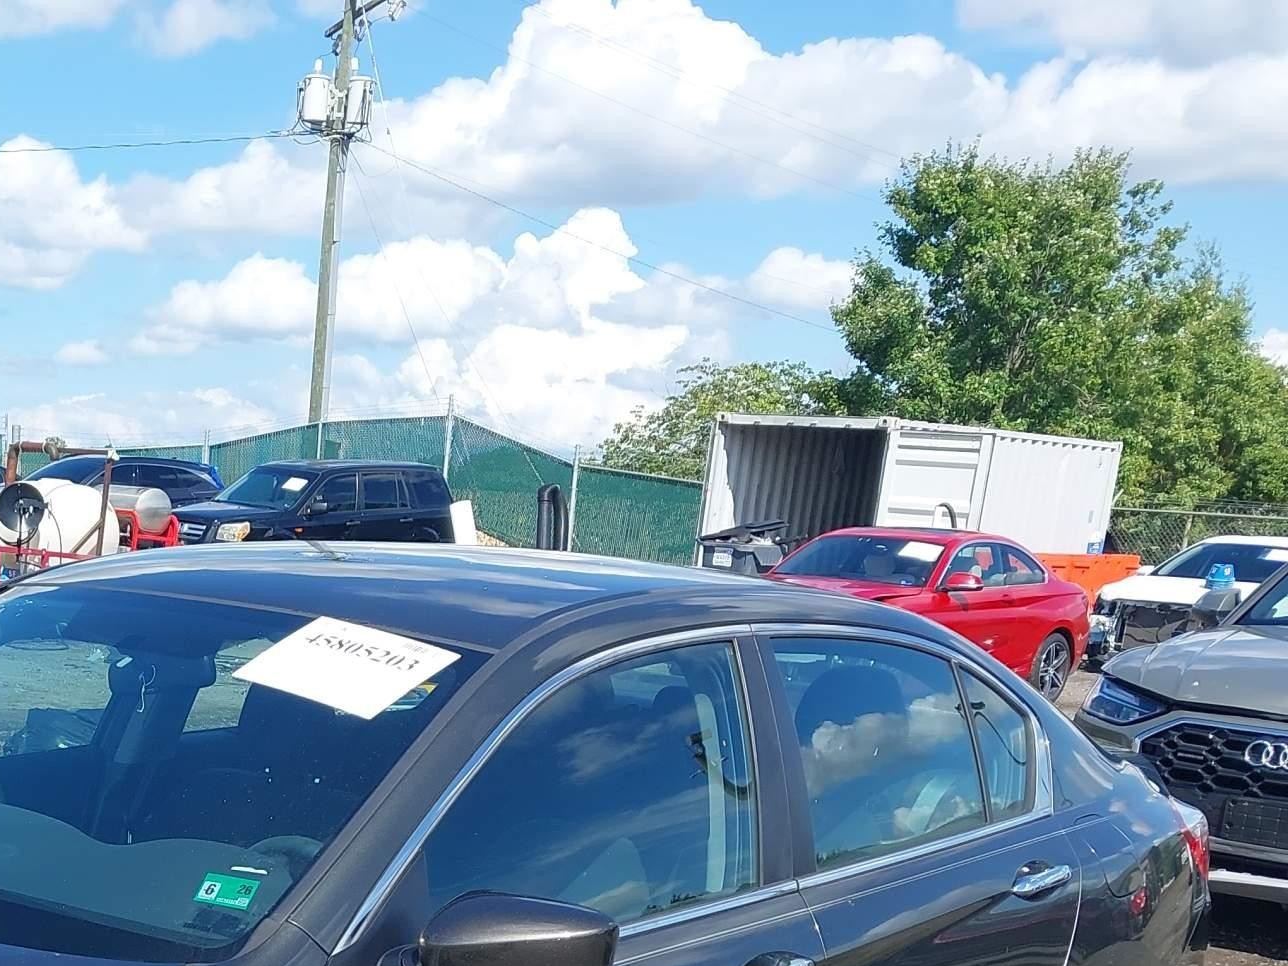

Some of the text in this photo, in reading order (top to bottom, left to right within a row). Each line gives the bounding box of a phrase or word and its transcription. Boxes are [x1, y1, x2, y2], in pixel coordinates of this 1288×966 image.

[304, 633, 420, 671] 45805203
[203, 883, 254, 896] 6 26
